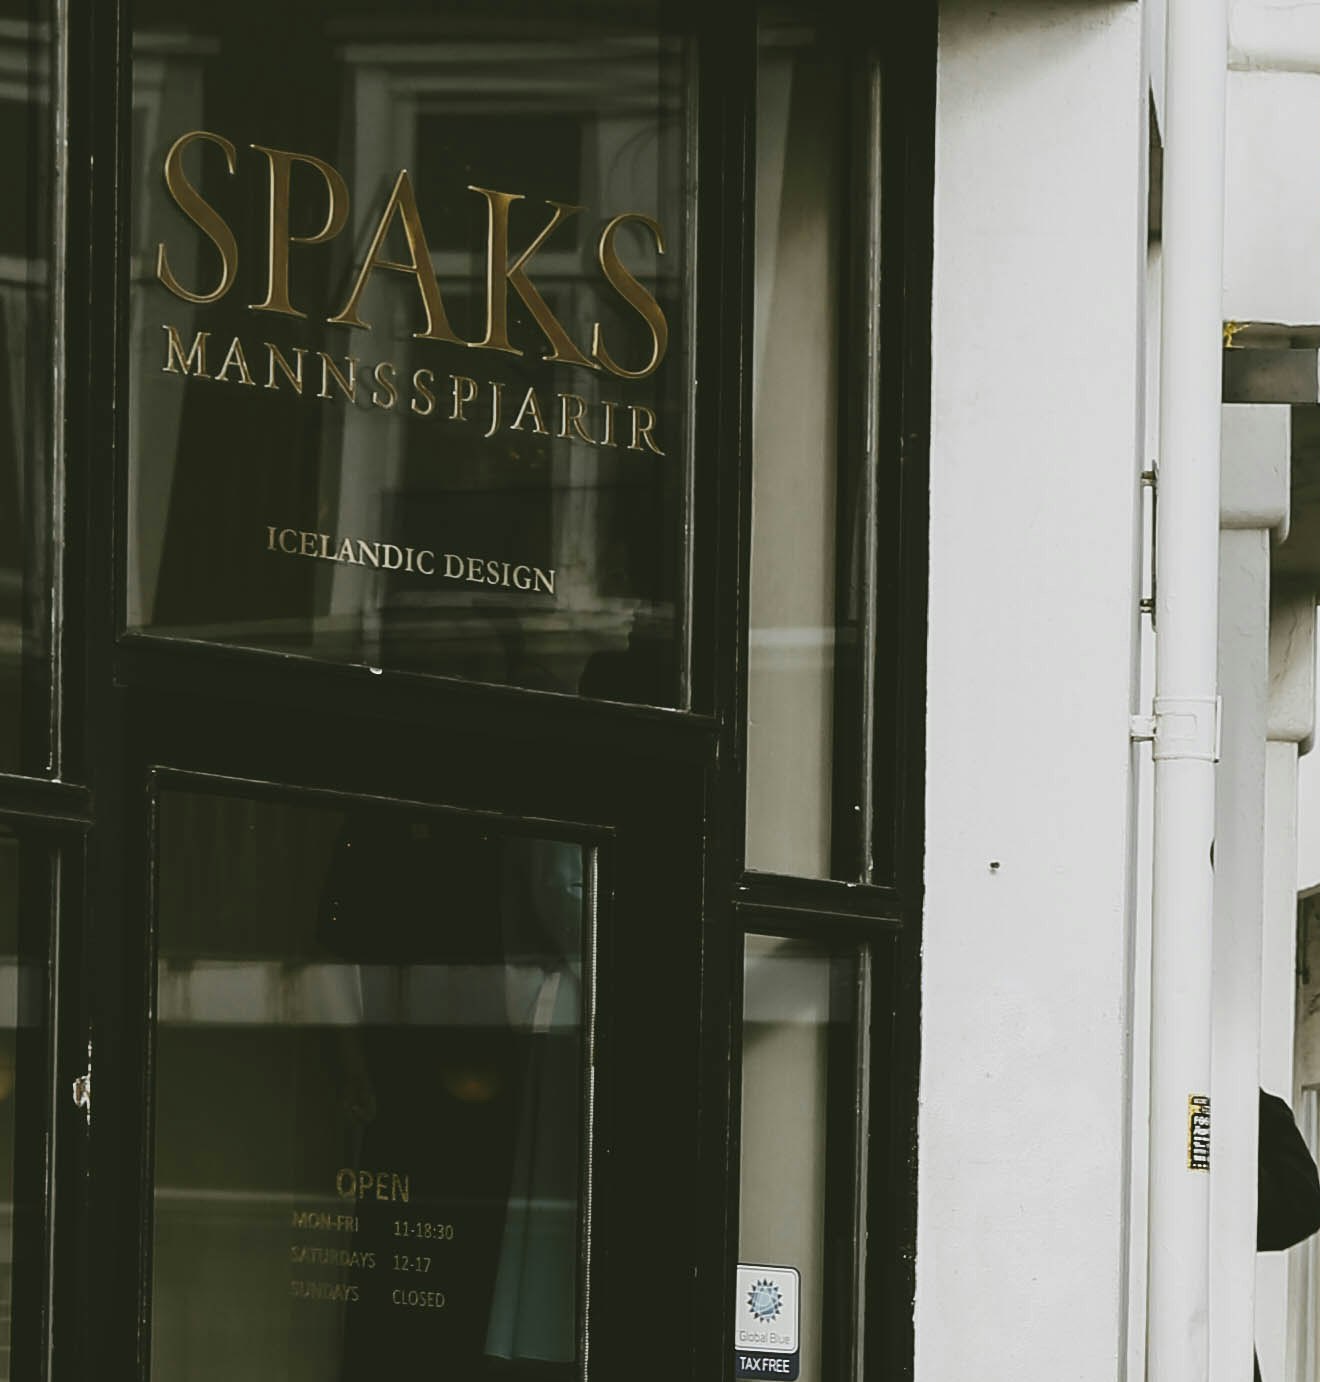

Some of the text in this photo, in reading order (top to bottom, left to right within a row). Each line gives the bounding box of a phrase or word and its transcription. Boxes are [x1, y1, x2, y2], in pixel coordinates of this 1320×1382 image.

[157, 131, 668, 379] SPAKS
[161, 324, 665, 456] MANNSSPJARIR
[267, 526, 556, 595] ICELANDIC DESIGN
[335, 1168, 410, 1203] OPEN
[393, 1220, 455, 1241] 11-18:30
[288, 1245, 432, 1273] SATURDAYS 12-17
[391, 1289, 446, 1308] CLOSED
[739, 1330, 791, 1345] Global Blue
[739, 1356, 790, 1374] TAX FREE
